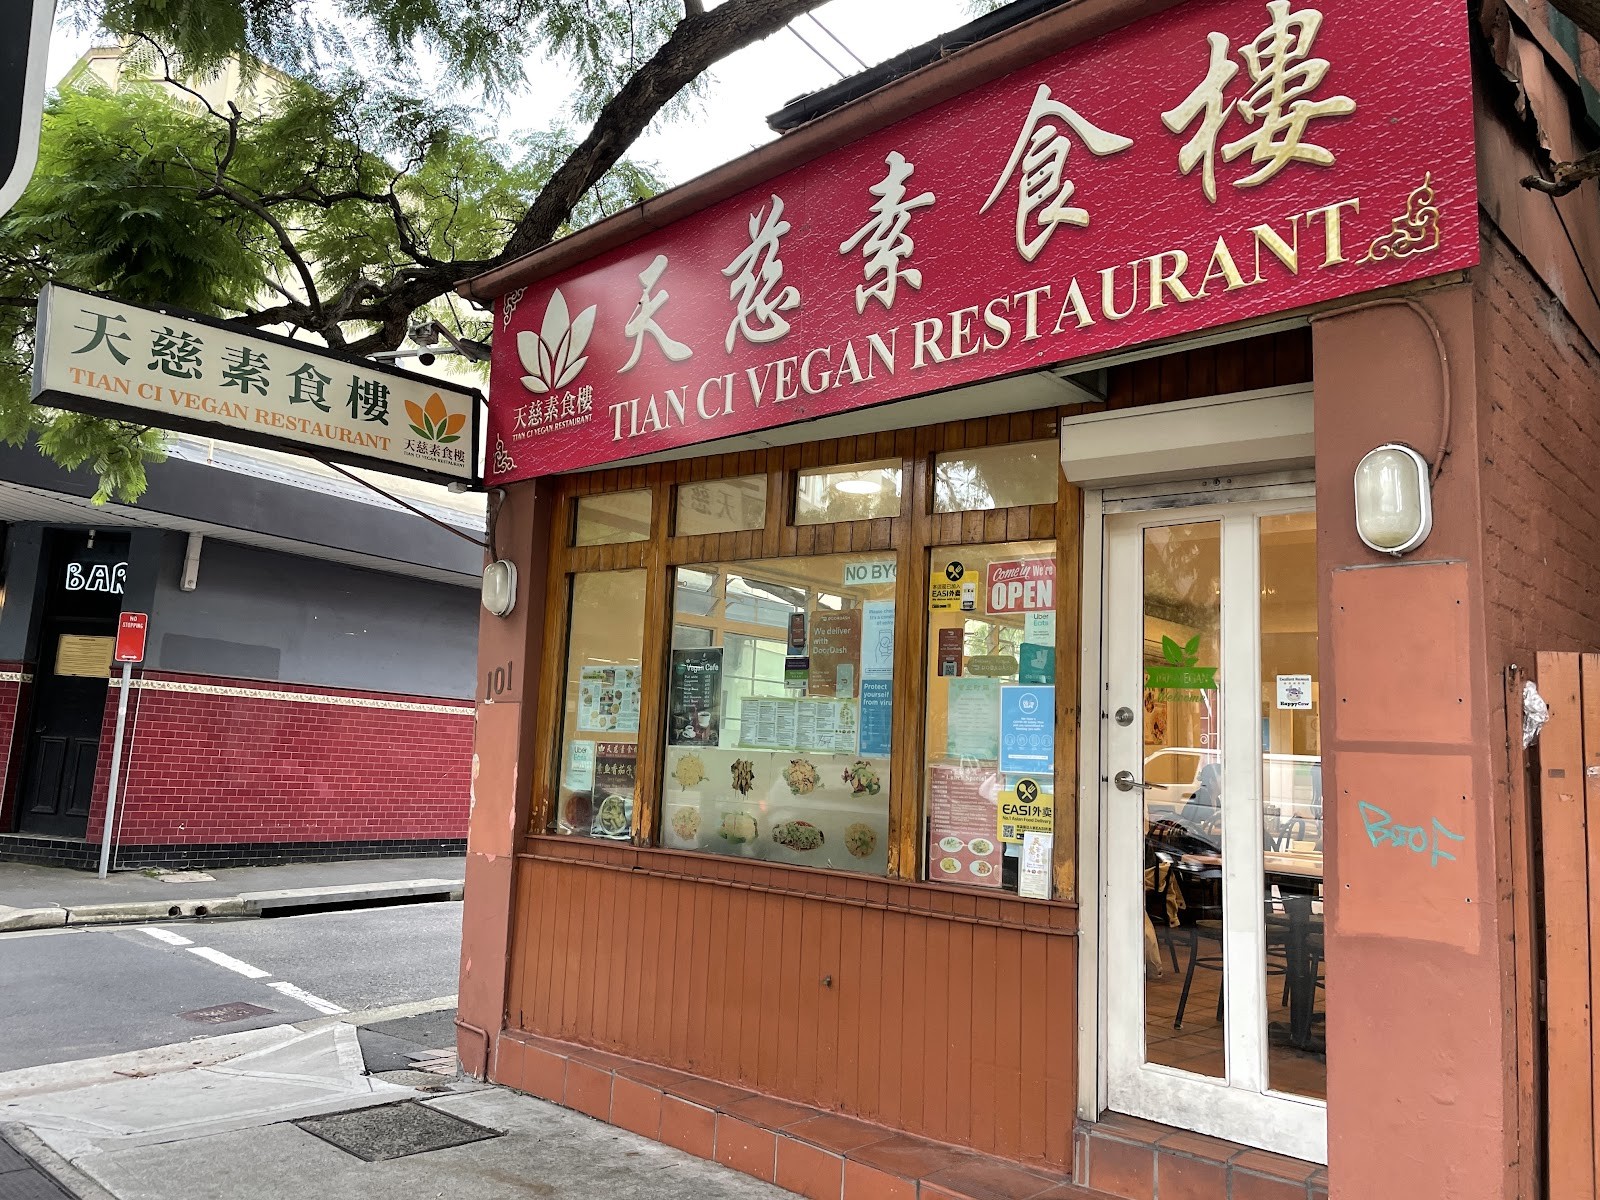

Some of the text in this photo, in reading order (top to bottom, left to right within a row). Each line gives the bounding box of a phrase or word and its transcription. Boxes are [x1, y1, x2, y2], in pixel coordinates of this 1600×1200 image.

[617, 0, 1356, 373] 天慈素食樓
[608, 198, 1361, 442] TIAN CI VEGAN RESTAURANT
[71, 309, 391, 426] 天慈素食樓
[69, 367, 391, 451] TIAN CI VEGAN RESTAURANT
[512, 385, 594, 432] 天慈素食樓
[512, 413, 592, 441] TIAN CI VEGAN RESTAURANT
[845, 565, 868, 581] NO
[993, 565, 1053, 582] Come in We're
[991, 580, 1053, 611] OPEN
[813, 637, 829, 645] with
[826, 626, 851, 635] deliver
[486, 661, 513, 700] 101
[705, 662, 719, 671] Cafe
[863, 691, 890, 699] yourself
